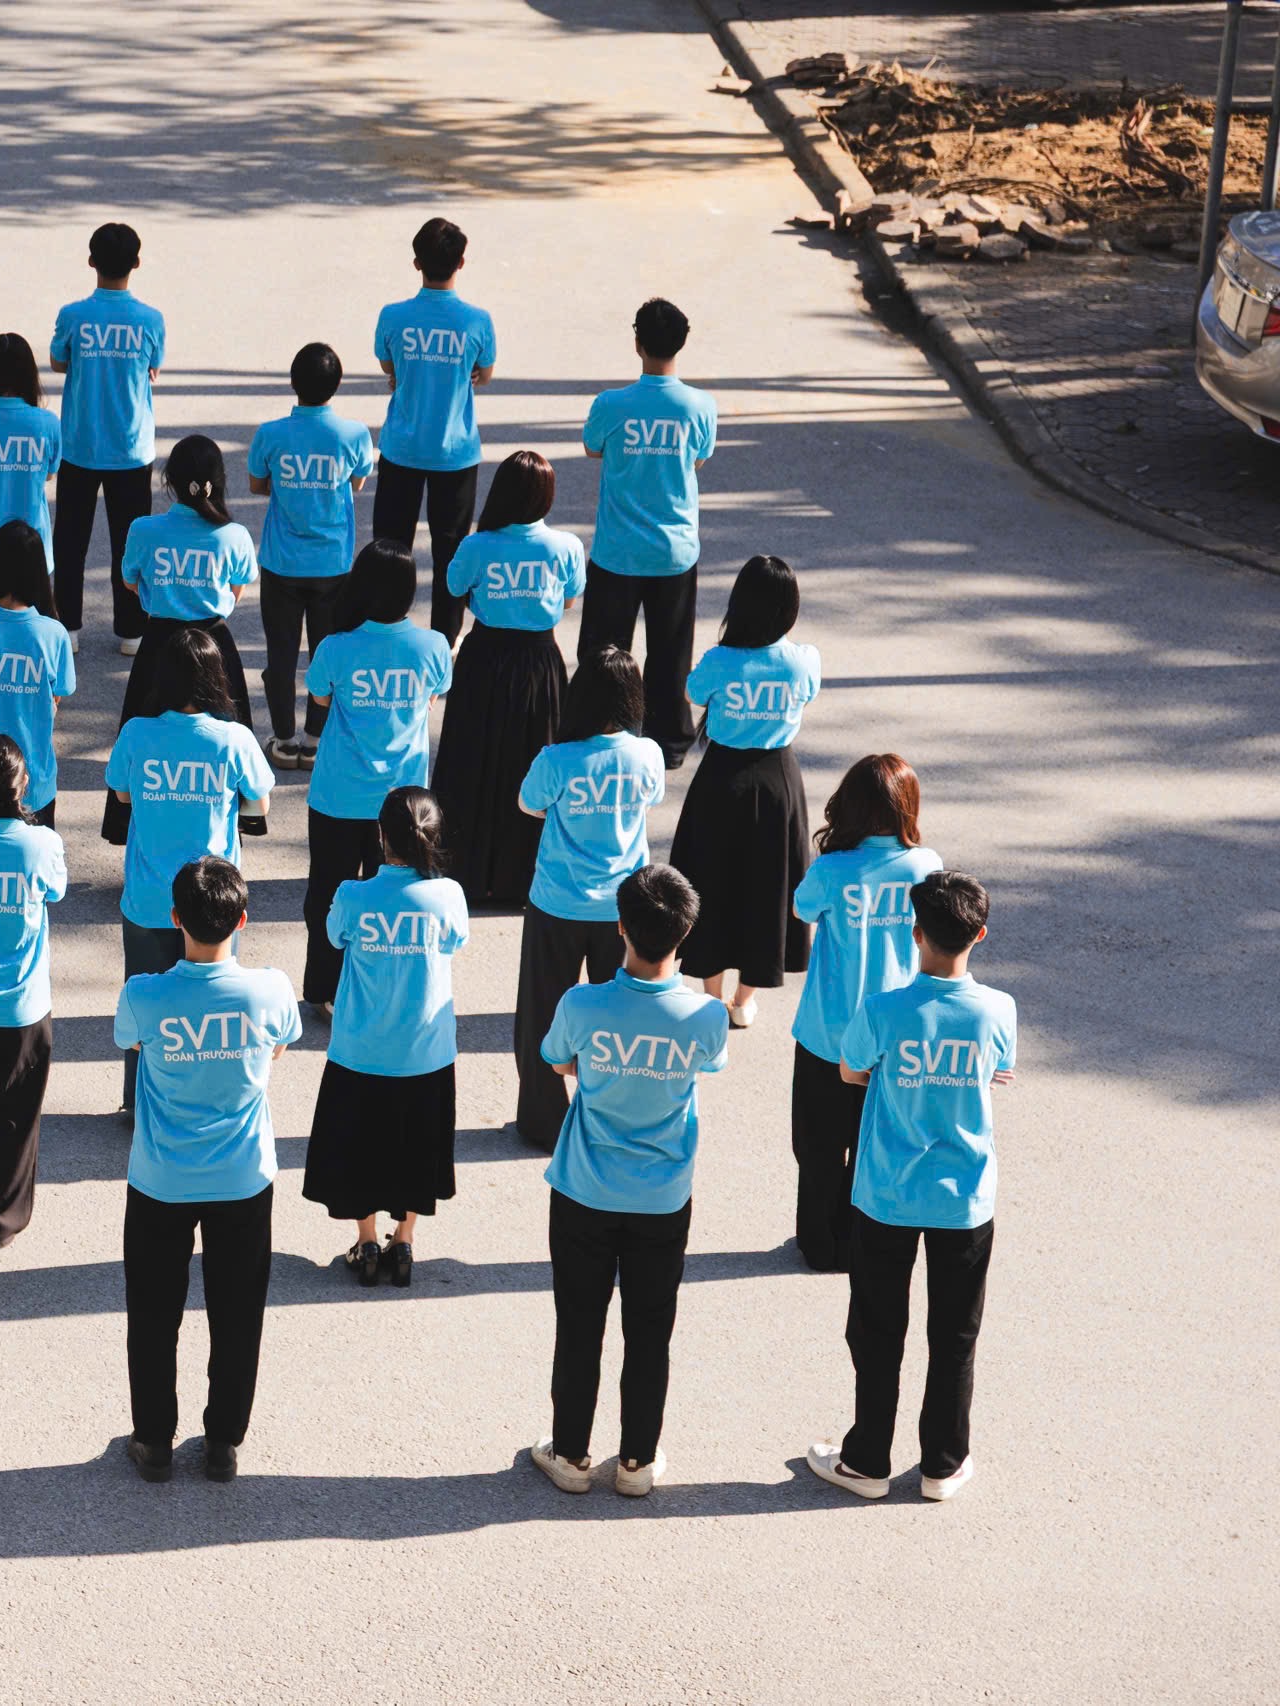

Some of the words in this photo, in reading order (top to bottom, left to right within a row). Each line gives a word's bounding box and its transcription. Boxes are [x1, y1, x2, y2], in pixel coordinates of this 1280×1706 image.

[80, 324, 143, 350] SVTN
[402, 327, 466, 355] SVTN
[624, 419, 690, 446] SVTN
[280, 454, 345, 481] SVTN
[154, 548, 226, 577] SVTN
[487, 561, 558, 590] SVTN
[352, 669, 427, 698] SVTN
[725, 681, 801, 710] SVTN
[143, 759, 224, 793] SVTN
[359, 912, 451, 942] SVTN
[159, 1011, 265, 1051] SVTN
[592, 1031, 696, 1070] SVTN
[899, 1040, 992, 1075] SVTN
